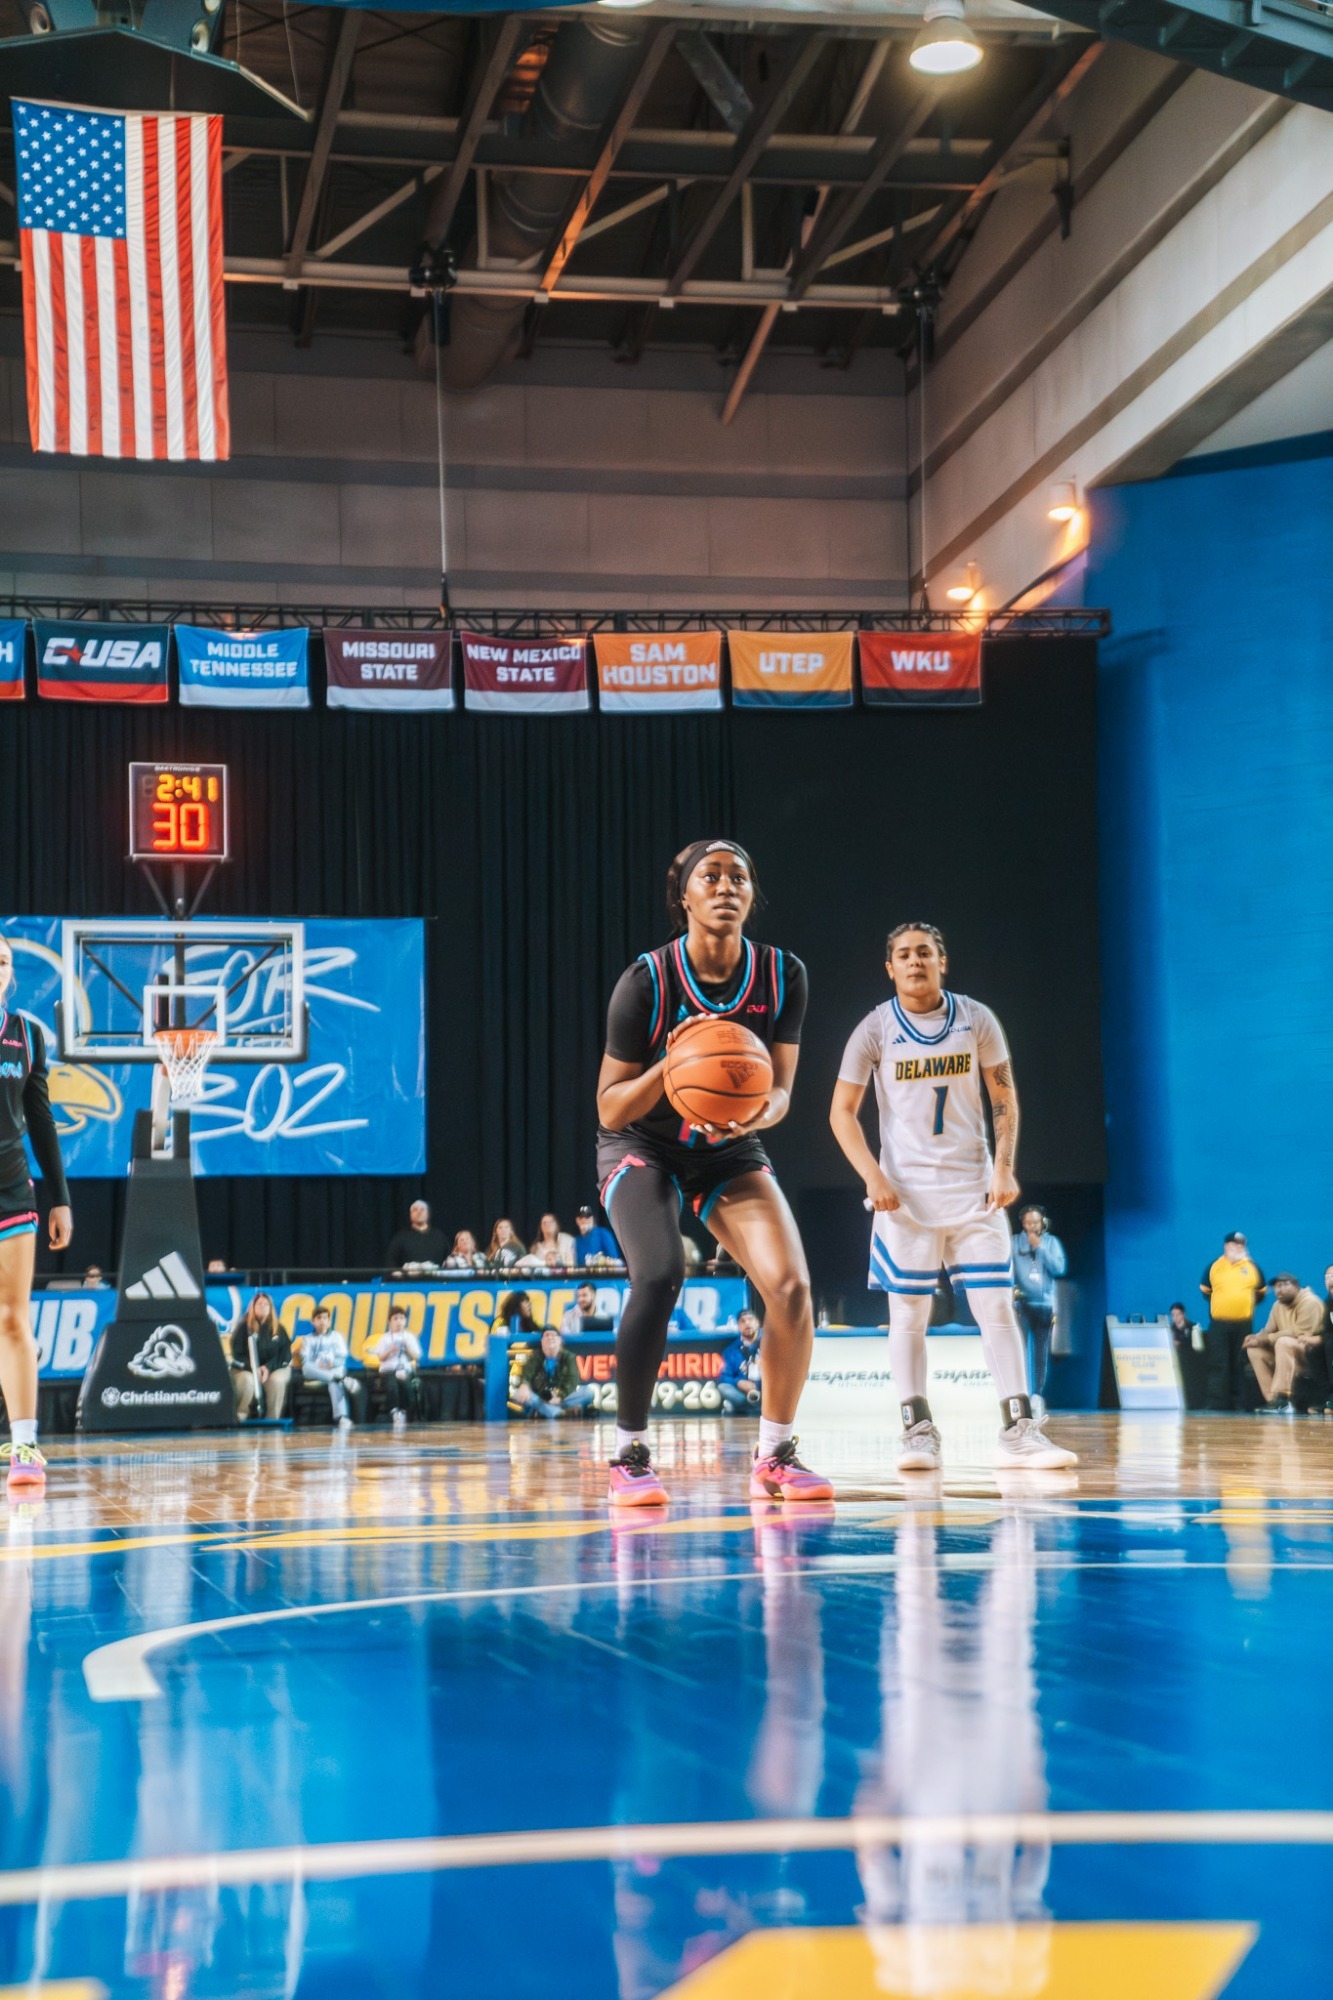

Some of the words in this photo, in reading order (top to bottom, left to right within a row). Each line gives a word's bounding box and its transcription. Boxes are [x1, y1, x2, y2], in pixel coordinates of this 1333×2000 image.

[207, 641, 279, 659] MIDDLE
[342, 641, 435, 660] MISSOURI
[466, 644, 509, 662] NEW
[513, 644, 581, 664] MEXICO
[630, 643, 686, 663] SAM
[189, 659, 297, 678] TENNESSEE
[759, 652, 824, 674] UTEP
[890, 650, 951, 672] WKU
[360, 663, 418, 681] STATE
[496, 666, 556, 682] STATE
[603, 662, 716, 686] HOUSTON
[156, 773, 219, 802] 2:41
[152, 802, 210, 851] 30
[895, 1053, 971, 1082] DELAWARE
[932, 1085, 949, 1136] 1
[806, 1370, 892, 1384] ESAPEAK
[120, 1389, 220, 1406] ChristianaCare
